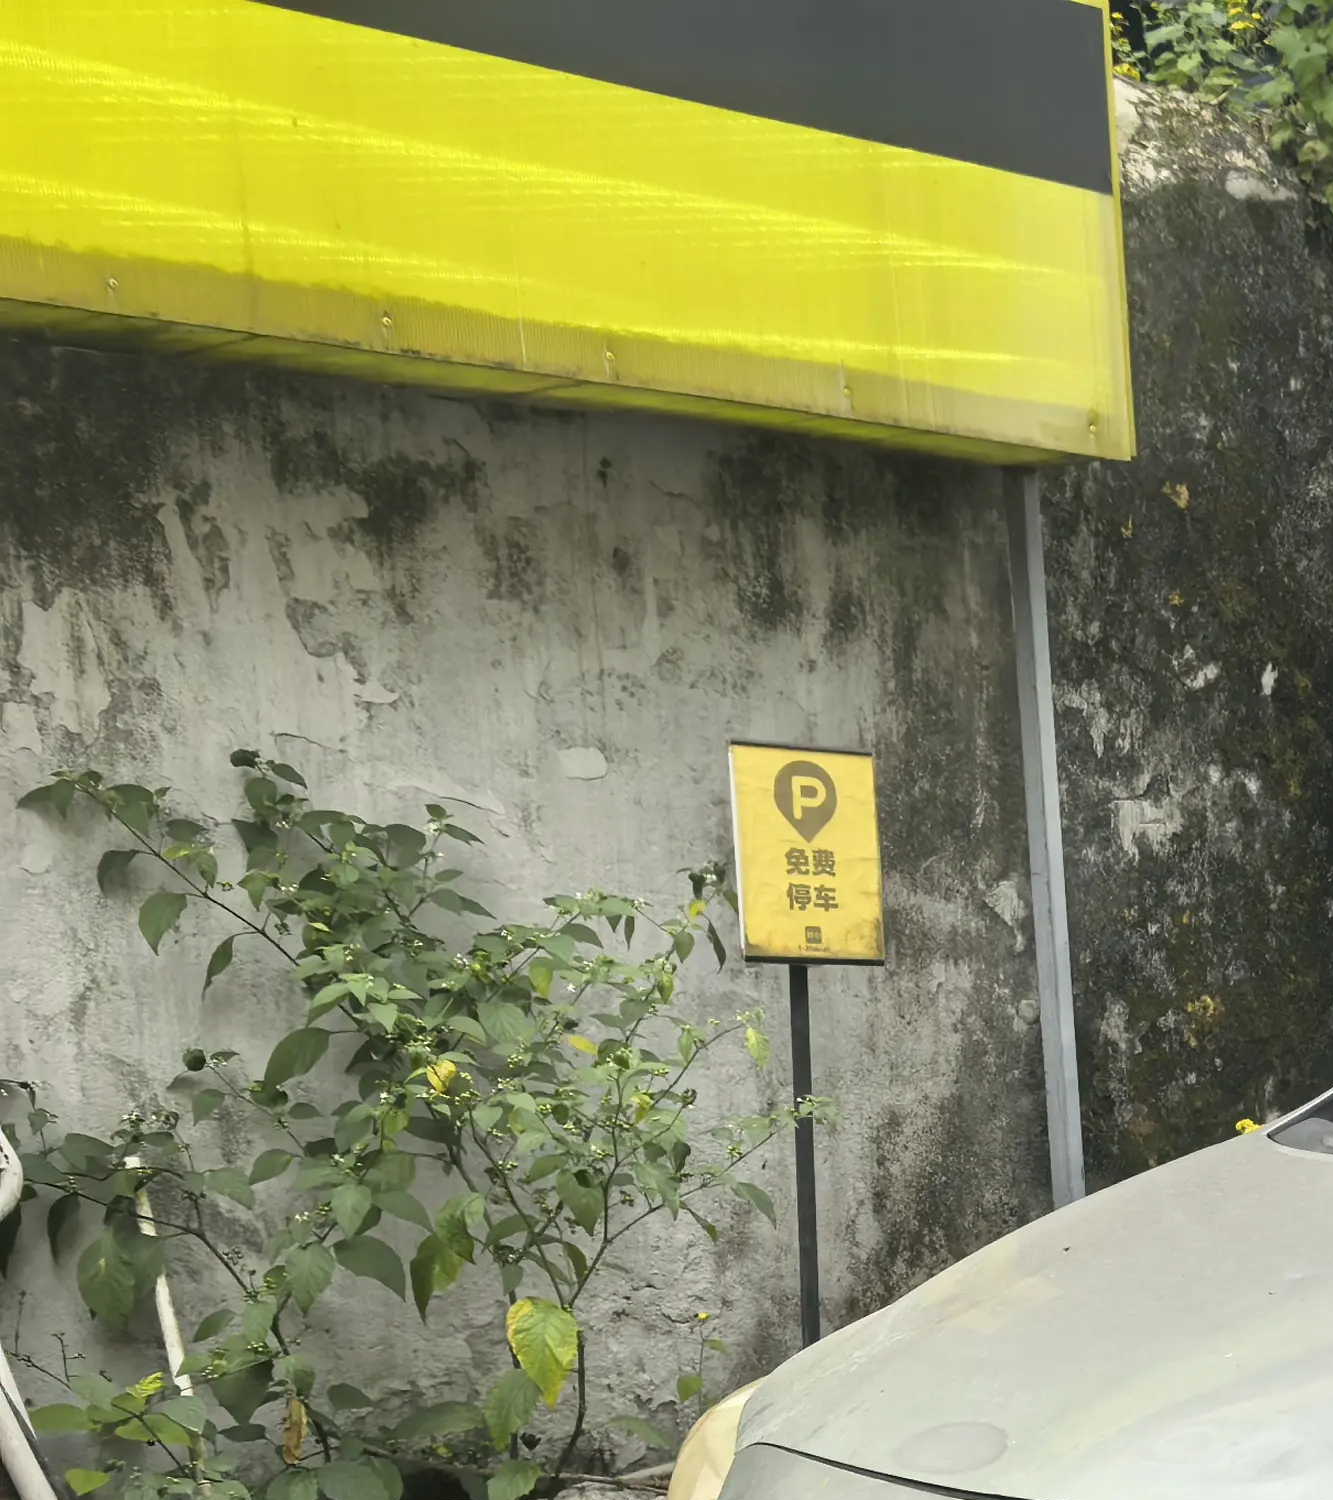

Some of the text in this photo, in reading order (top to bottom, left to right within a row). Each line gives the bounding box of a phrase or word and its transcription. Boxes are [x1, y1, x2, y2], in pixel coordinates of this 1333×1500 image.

[791, 775, 827, 820] P
[784, 847, 837, 878] 免费
[785, 882, 839, 913] 停车
